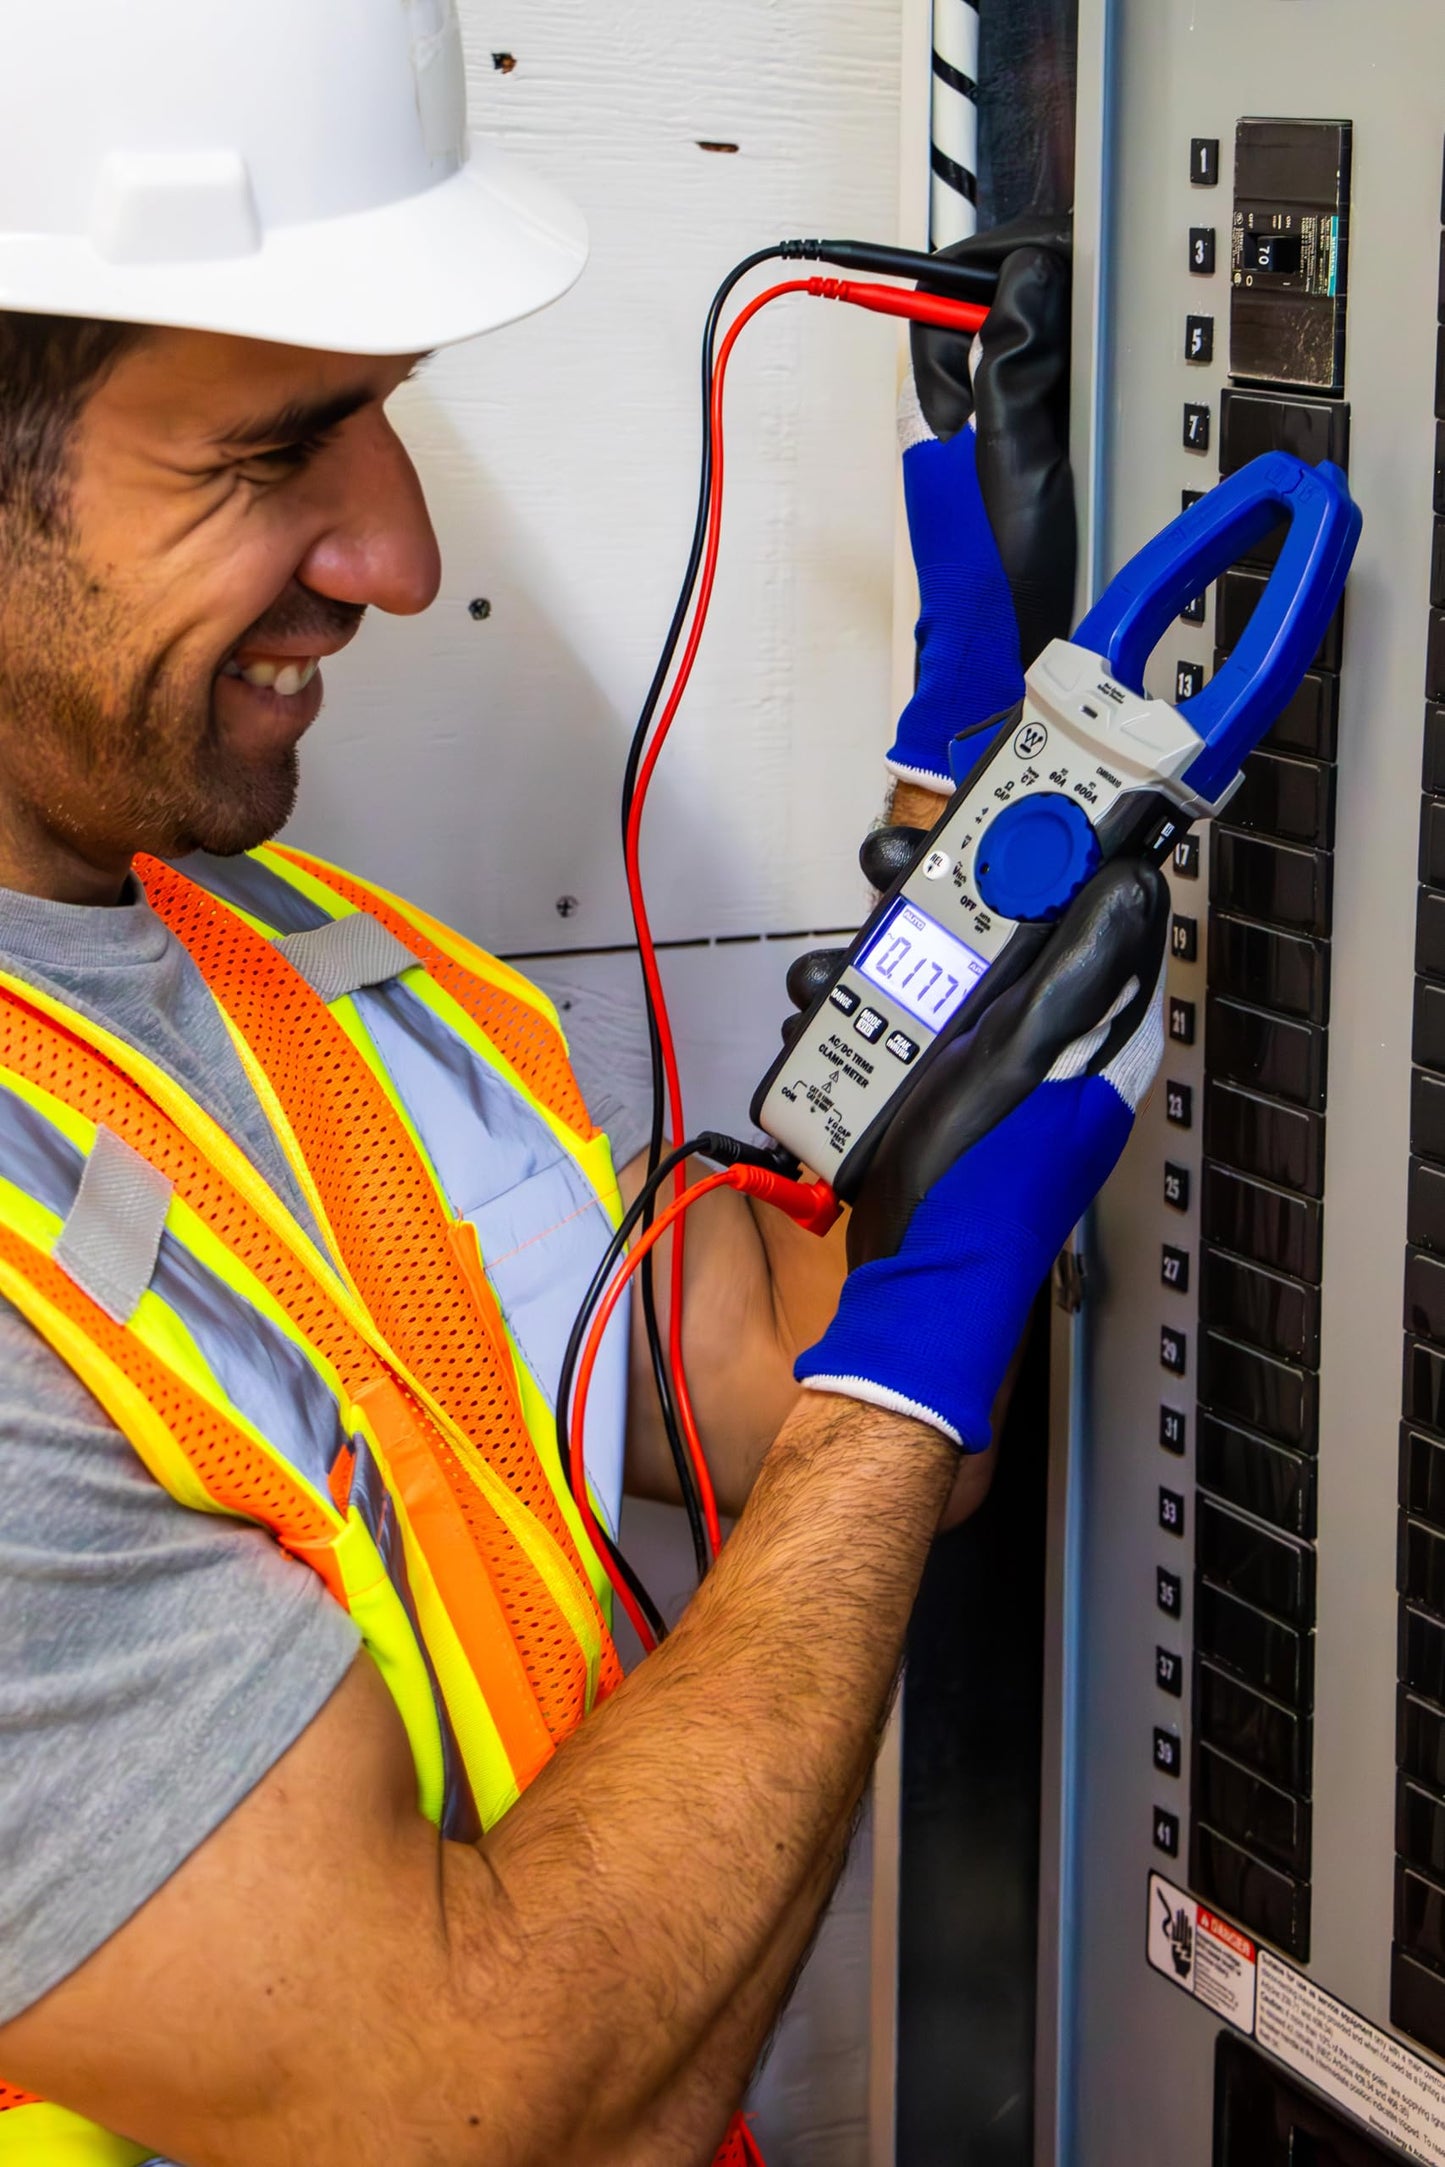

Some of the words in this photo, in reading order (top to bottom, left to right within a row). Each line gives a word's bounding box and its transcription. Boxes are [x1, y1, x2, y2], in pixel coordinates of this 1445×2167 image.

[1200, 148, 1206, 173] 1
[1195, 240, 1204, 264] 3
[1258, 245, 1270, 265] 70
[1192, 328, 1202, 355] 5
[1190, 415, 1199, 440] 7
[1178, 672, 1193, 697] 13
[994, 788, 1010, 801] CAP
[1074, 783, 1098, 804] 600A
[930, 853, 943, 867] REL
[1175, 842, 1190, 867] 17
[960, 895, 977, 911] OFF
[903, 909, 925, 931] AUTO
[1173, 925, 1186, 949] 19
[876, 936, 960, 1014] 0.177
[830, 988, 853, 1009] RANGE
[860, 1009, 882, 1029] MODE
[828, 1034, 853, 1058] AC/DC
[852, 1053, 874, 1074] TRMS
[887, 1039, 910, 1060] INRUSH
[894, 1034, 912, 1051] PEAK
[818, 1044, 844, 1067] CLAMP
[842, 1063, 869, 1089] METER
[781, 1086, 797, 1102] COM
[806, 1091, 816, 1101] CAT
[810, 1085, 819, 1095] CAT
[1170, 1093, 1184, 1118] 23
[838, 1125, 851, 1138] CAP
[1166, 1175, 1180, 1201] 25
[1163, 1256, 1180, 1281] 27
[1161, 1337, 1177, 1364] 29
[1165, 1416, 1178, 1442] 31
[1162, 1498, 1177, 1524] 33
[1160, 1580, 1174, 1607] 35
[1159, 1655, 1174, 1681] 37
[1157, 1738, 1173, 1764] 39
[1156, 1821, 1171, 1847] 41
